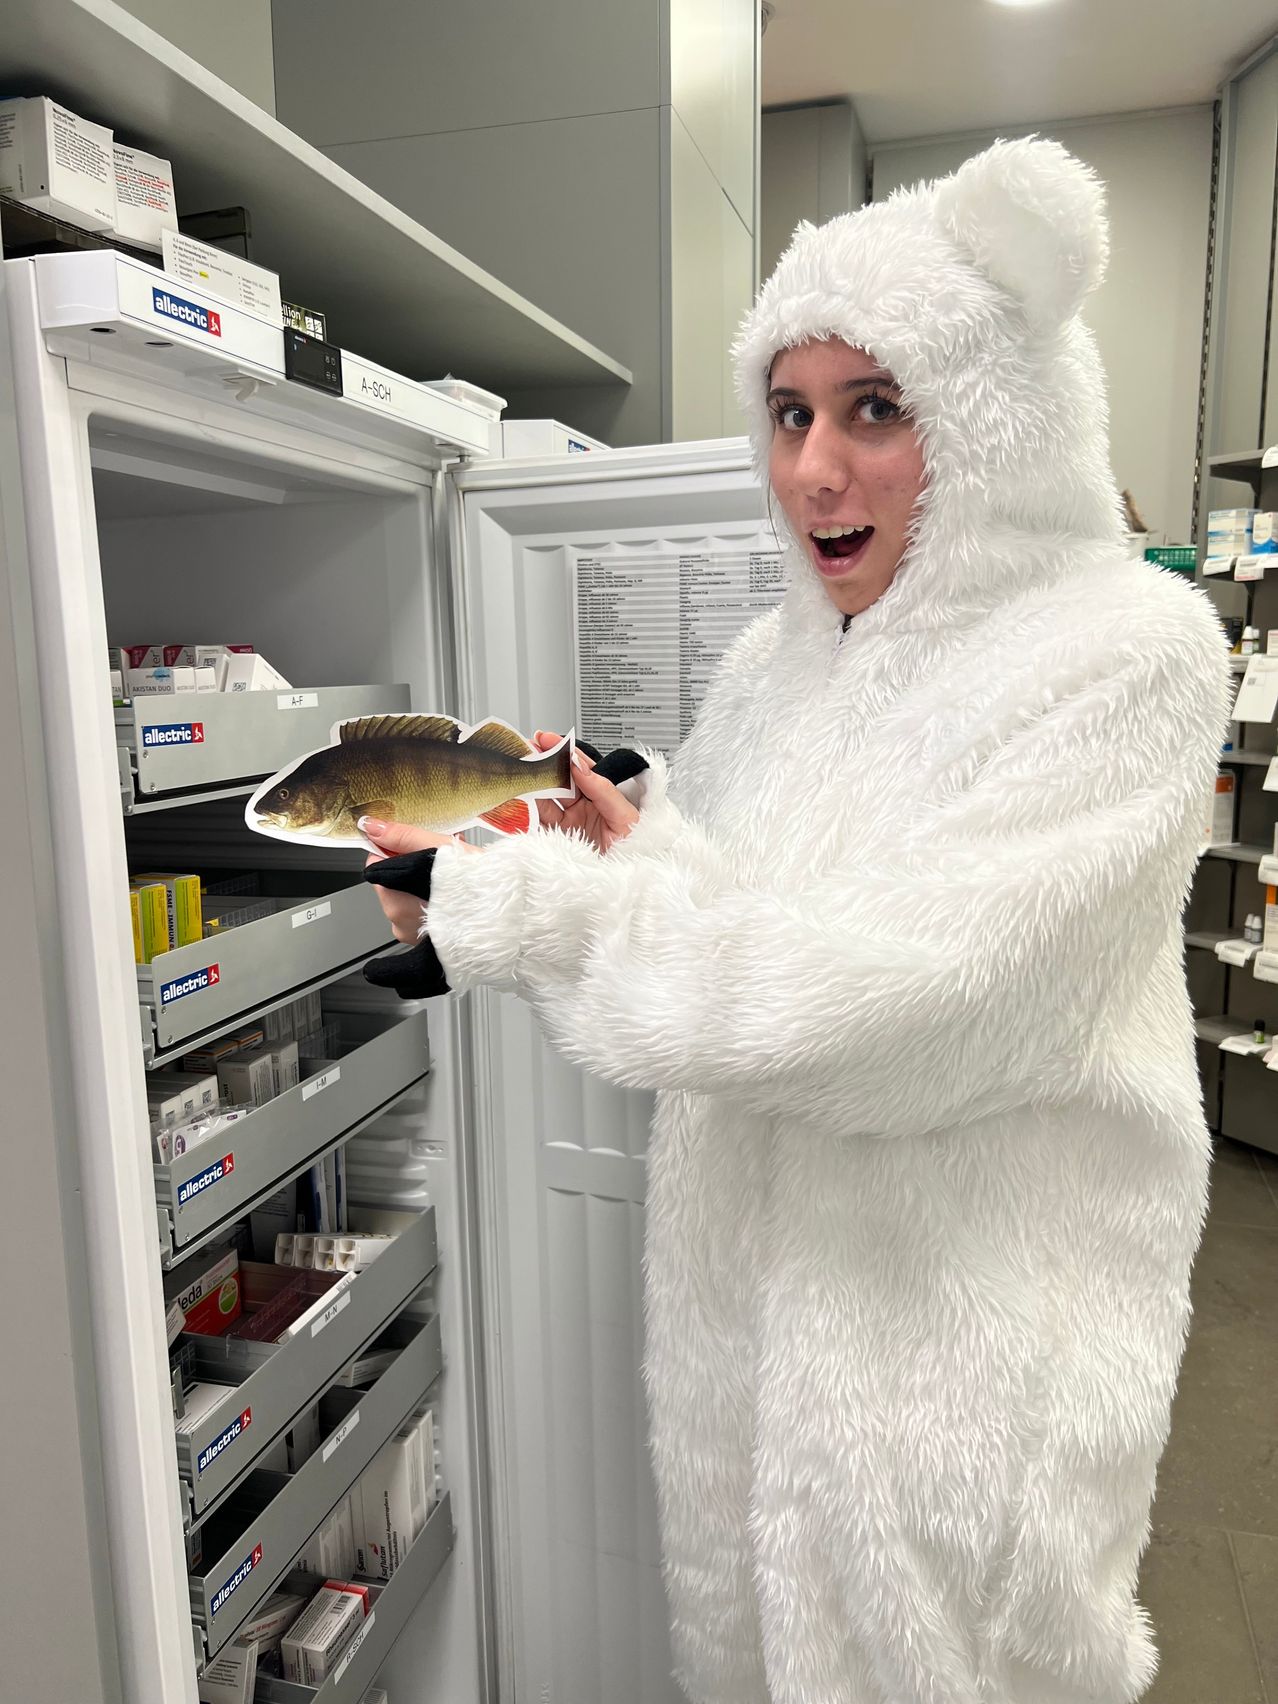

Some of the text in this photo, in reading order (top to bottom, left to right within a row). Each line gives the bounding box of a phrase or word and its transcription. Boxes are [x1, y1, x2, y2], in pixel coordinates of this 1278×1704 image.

[155, 295, 208, 328] allectric
[361, 377, 392, 403] A-SCH
[291, 695, 304, 707] A-F
[144, 726, 192, 744] allectric
[306, 910, 317, 920] G-I
[162, 973, 208, 1002] allectric
[316, 1075, 327, 1090] I-M
[179, 1166, 223, 1202] allectric
[324, 1304, 338, 1322] M-N
[199, 1420, 241, 1470] allectric
[335, 1426, 348, 1444] N-P
[212, 1560, 252, 1612] allectric
[346, 1631, 364, 1663] R-SCH
